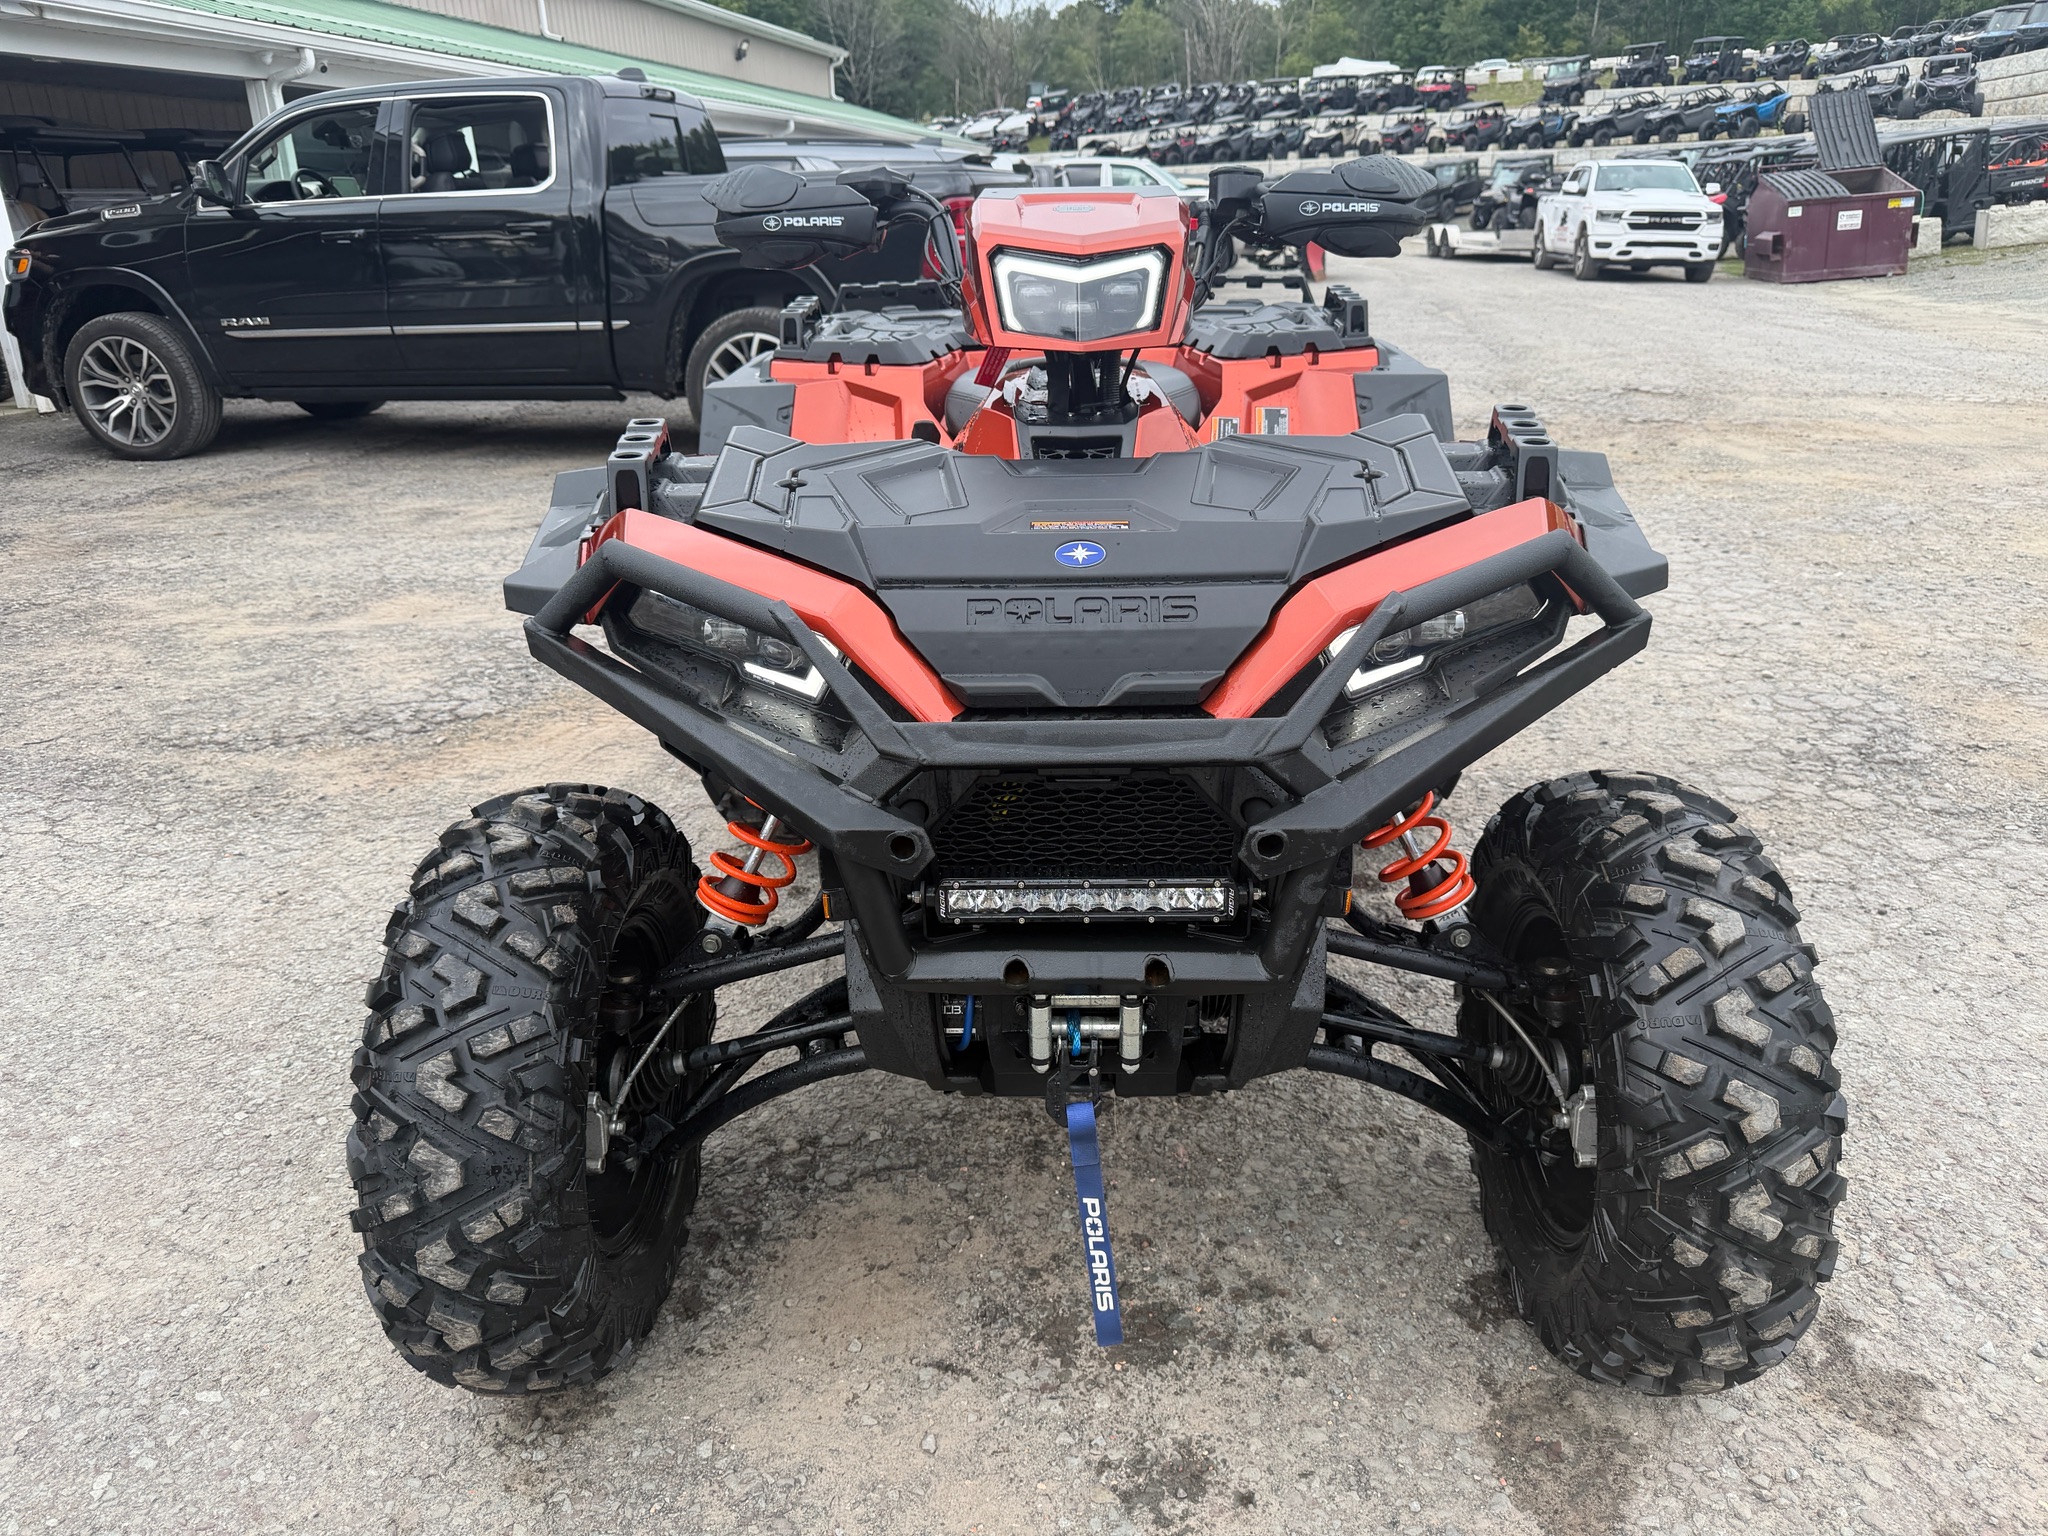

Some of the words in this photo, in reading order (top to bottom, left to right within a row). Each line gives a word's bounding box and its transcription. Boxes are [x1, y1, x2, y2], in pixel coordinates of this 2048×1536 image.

[220, 316, 271, 326] RAM
[966, 595, 1199, 625] POLARIS
[1082, 1197, 1115, 1312] POLARIS
